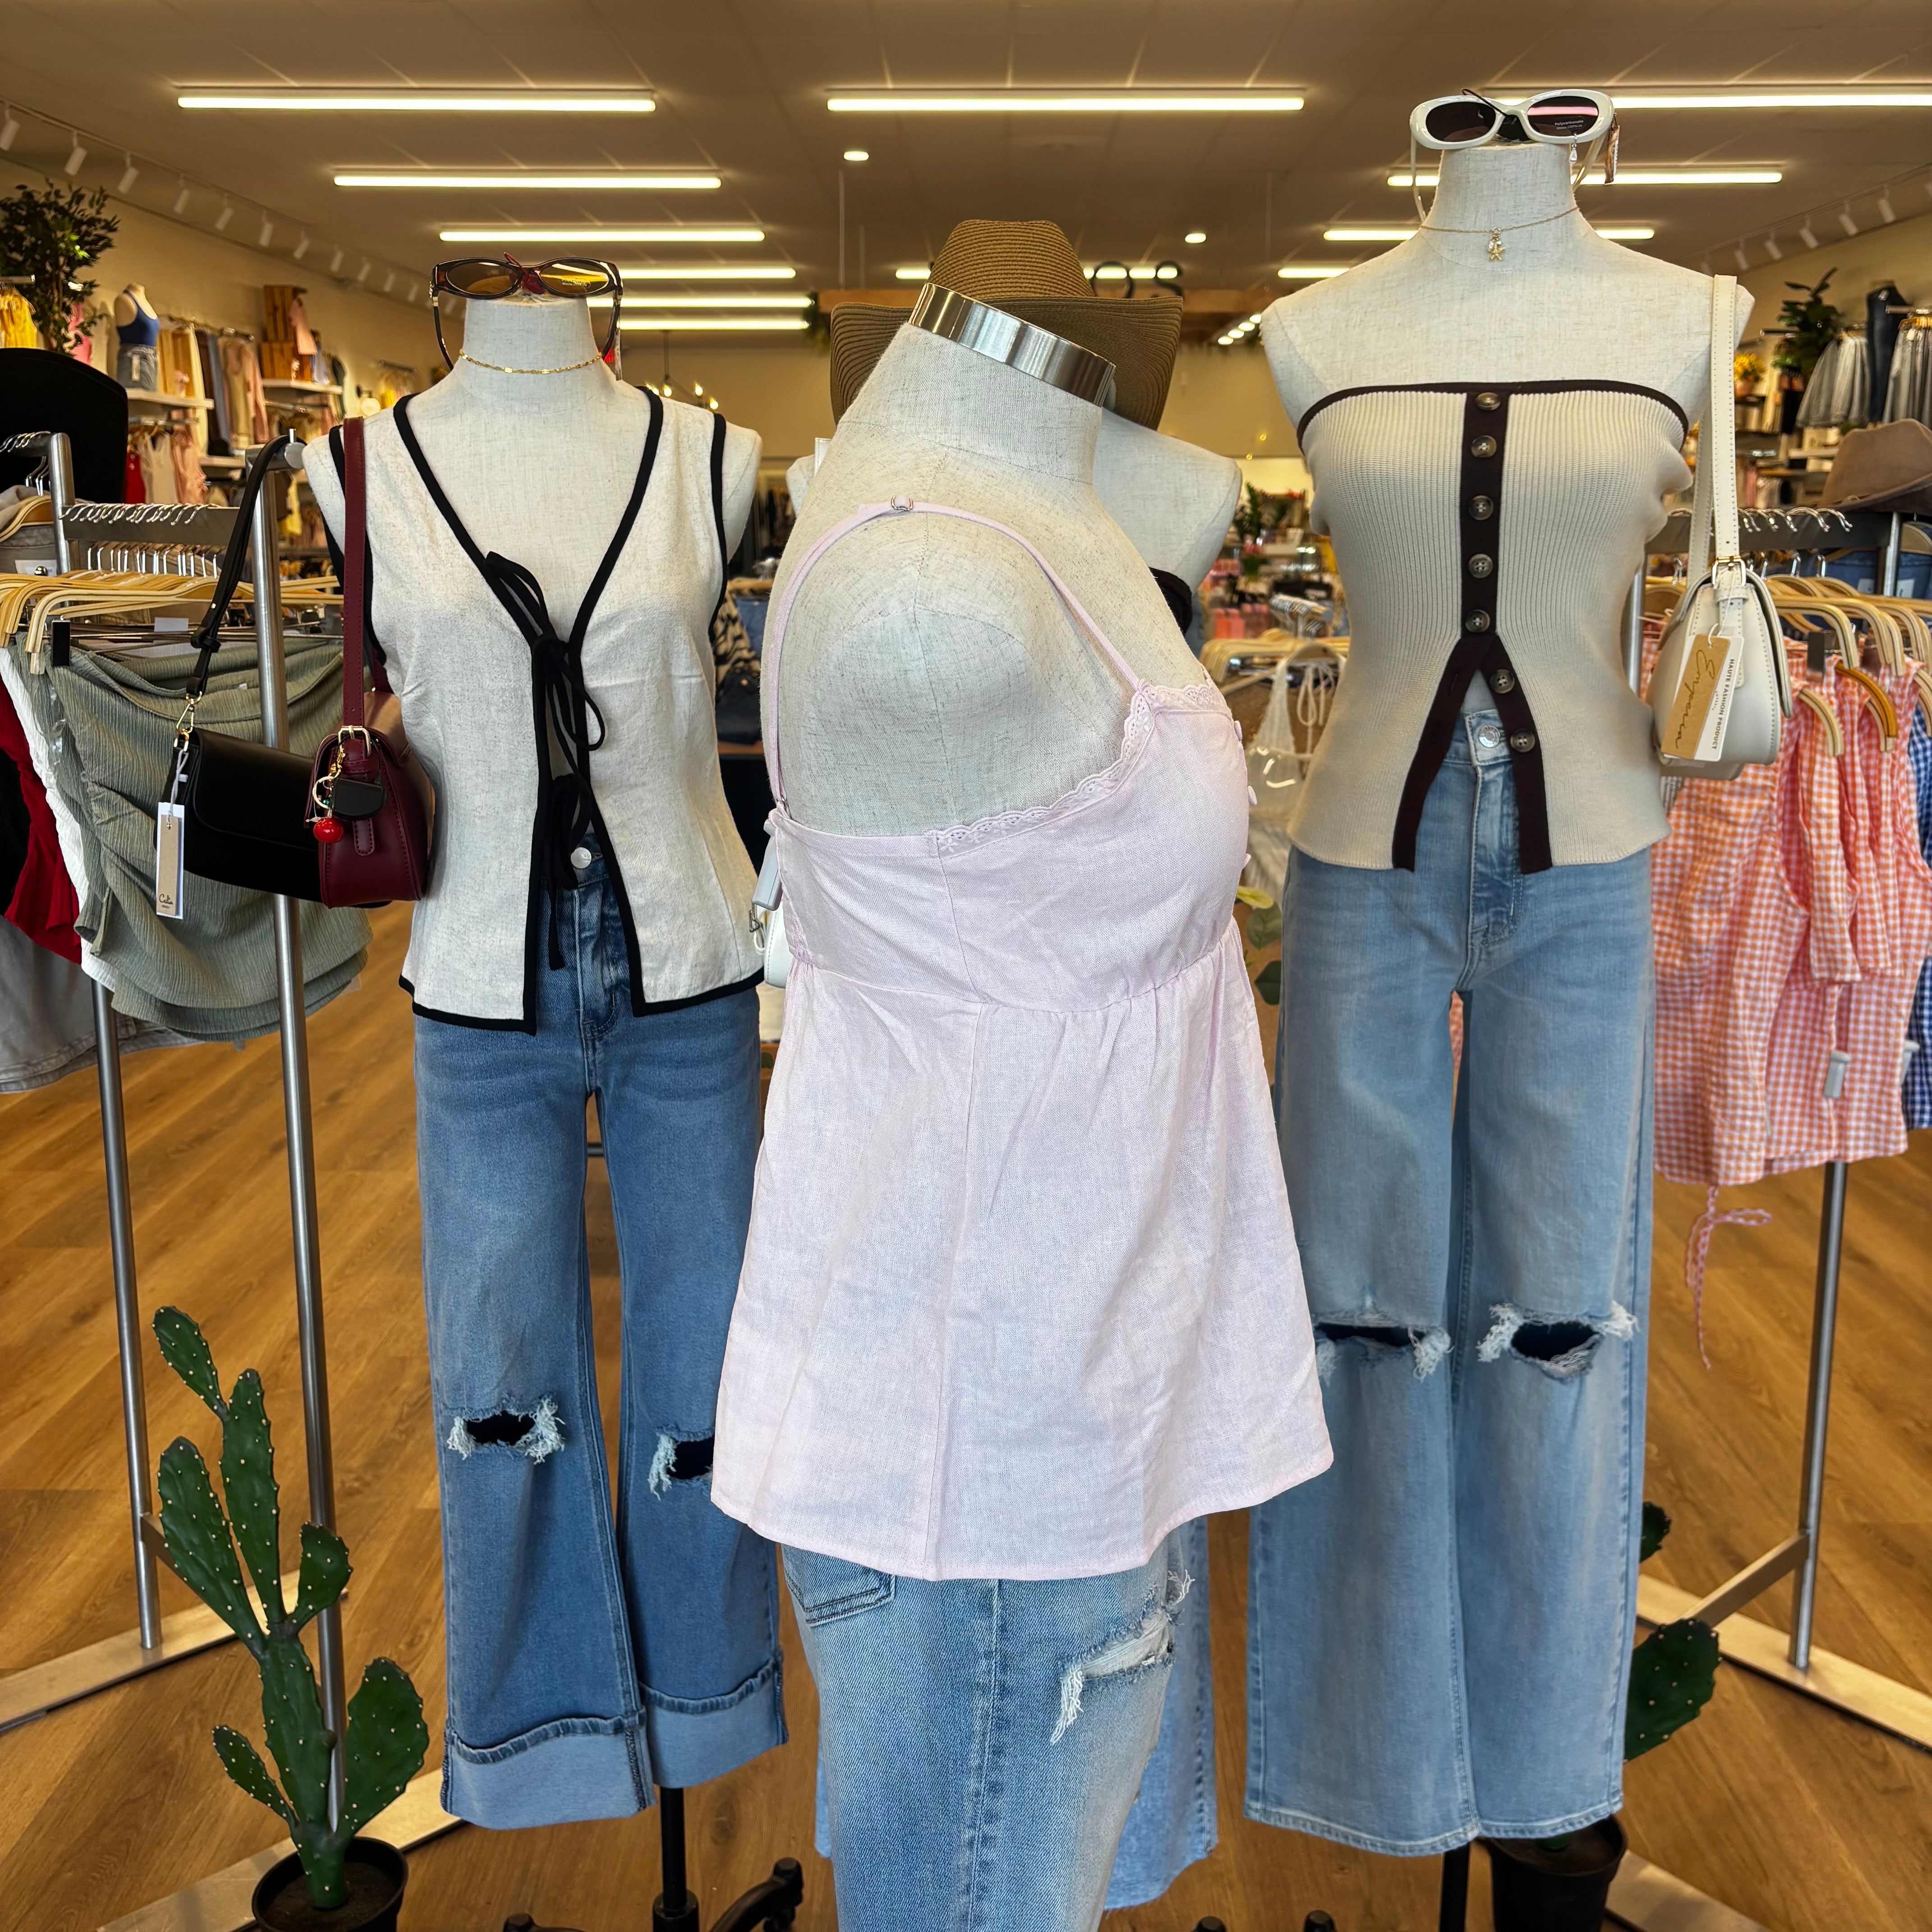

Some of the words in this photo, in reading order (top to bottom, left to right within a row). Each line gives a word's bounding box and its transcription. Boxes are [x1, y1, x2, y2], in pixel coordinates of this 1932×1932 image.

[1725, 658, 1735, 682] HAUTE
[1719, 684, 1729, 715] FASHION
[1712, 718, 1722, 750] PRODUCT
